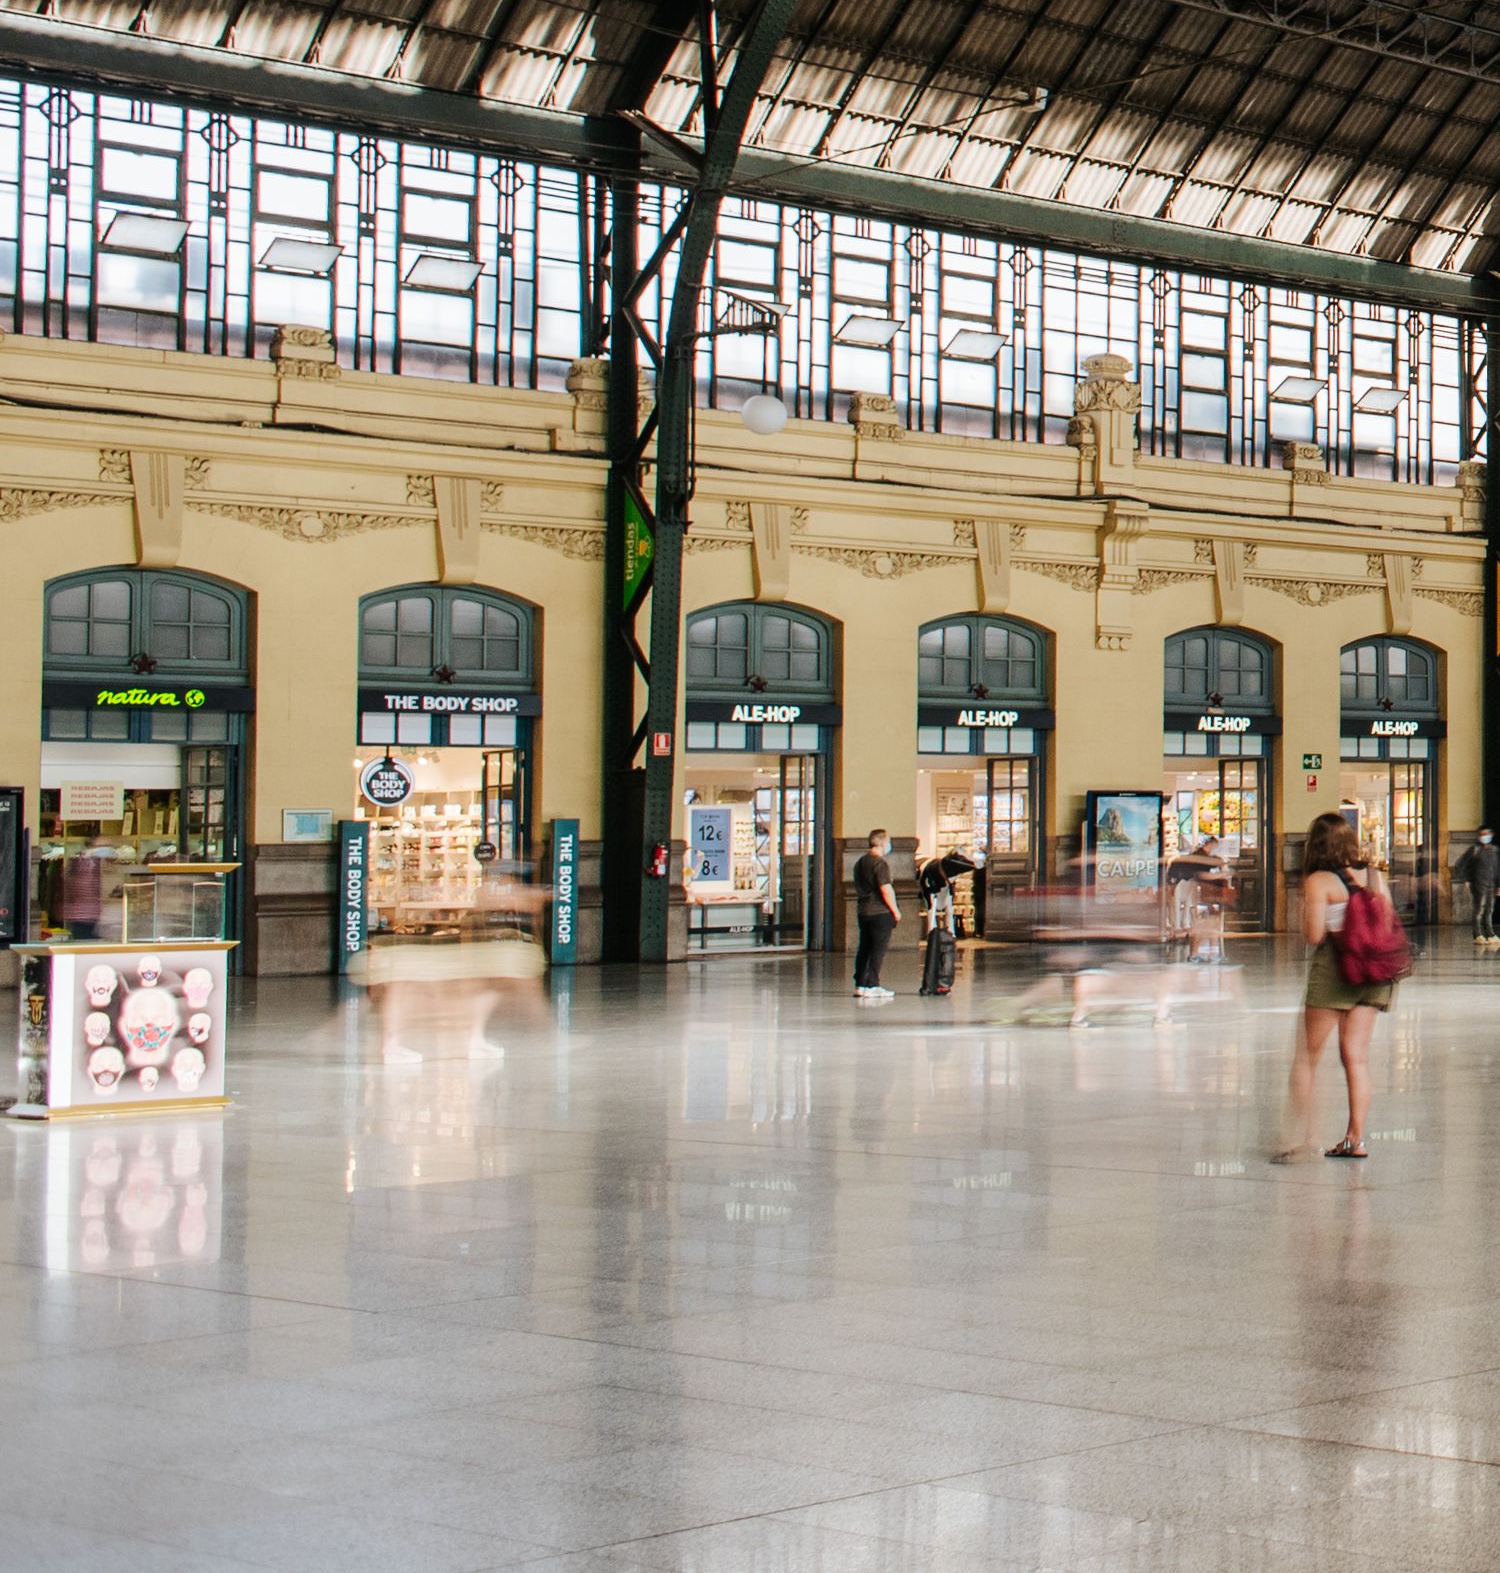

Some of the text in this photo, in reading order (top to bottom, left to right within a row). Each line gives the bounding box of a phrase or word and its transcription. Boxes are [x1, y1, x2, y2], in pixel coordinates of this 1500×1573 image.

[624, 522, 635, 581] tiendas
[96, 688, 181, 706] natura
[384, 694, 419, 710] THE
[422, 696, 470, 712] BODY
[732, 705, 801, 723] ALE-HOP
[958, 710, 1018, 727] ALE-HOP
[1198, 716, 1251, 732] ALE-HOP
[1371, 720, 1418, 736] ALE-HOP
[371, 780, 405, 789] BODY
[378, 771, 398, 780] THE
[373, 789, 404, 798] SHOP
[348, 836, 363, 865] THE
[560, 834, 573, 862] THE
[1097, 859, 1156, 878] CALPE
[347, 869, 362, 909] BODY
[559, 865, 573, 903] BODY
